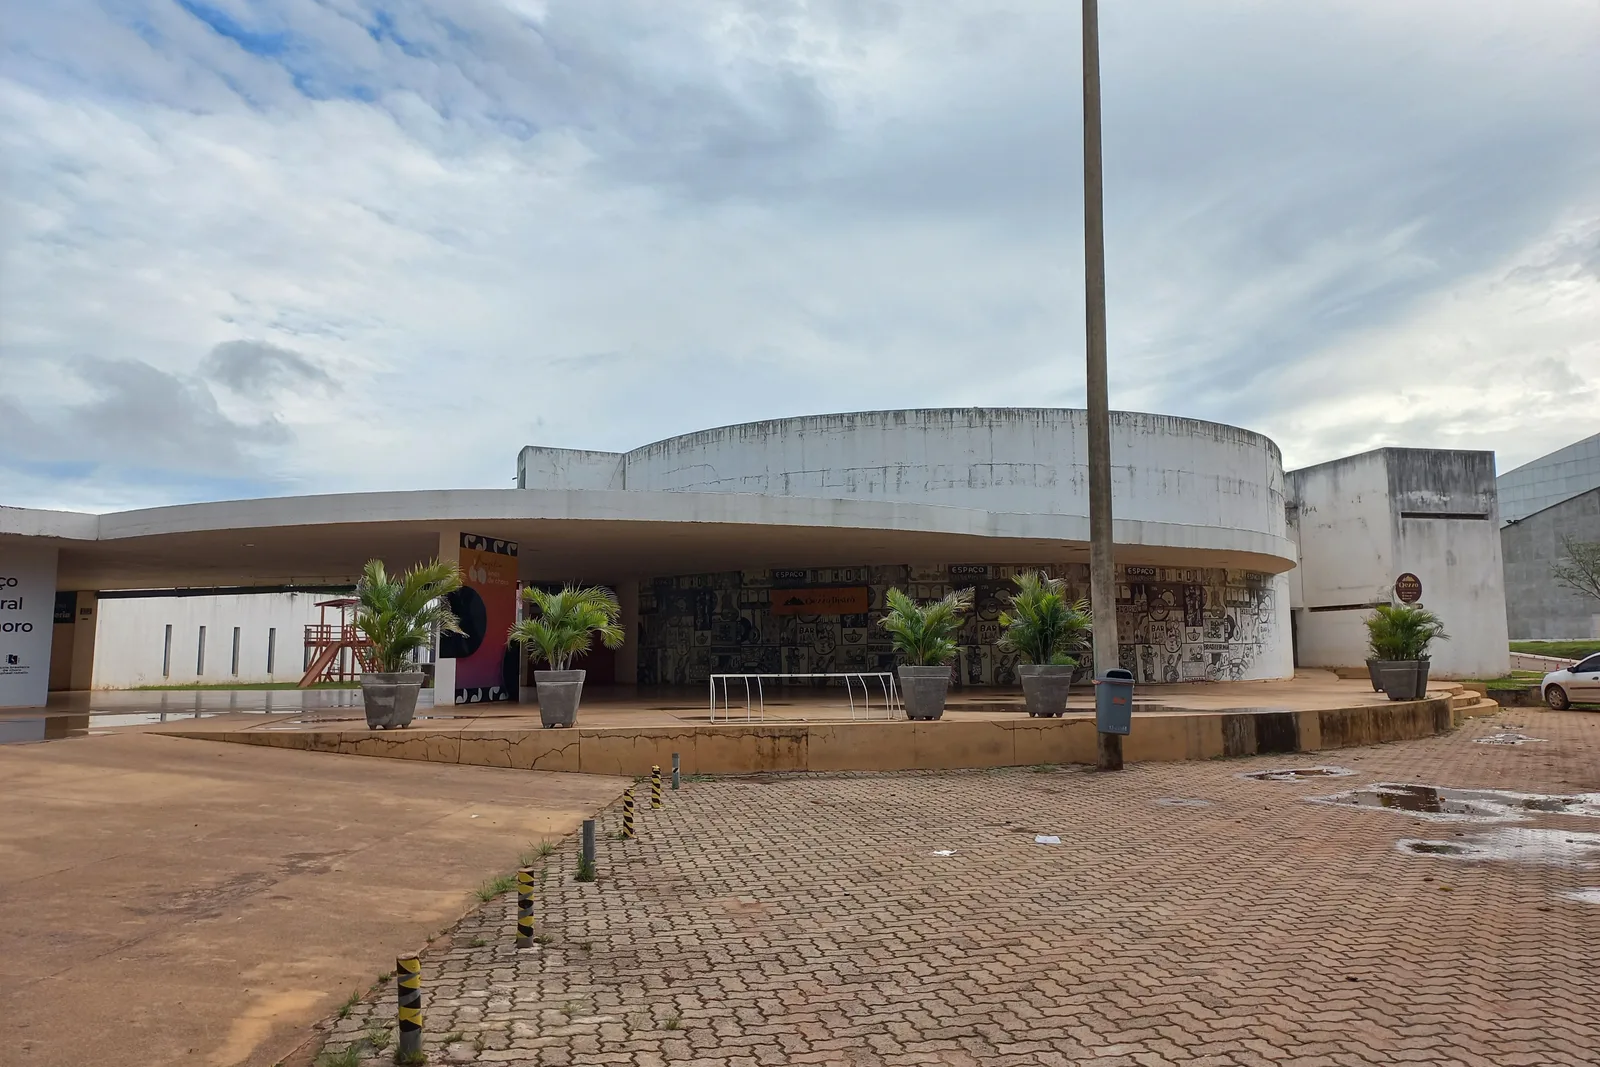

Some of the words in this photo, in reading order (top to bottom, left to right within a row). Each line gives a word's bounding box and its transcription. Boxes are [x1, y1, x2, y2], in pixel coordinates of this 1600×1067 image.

[0, 597, 23, 610] ral
[0, 622, 33, 632] oro
[799, 626, 815, 634] BAR
[981, 624, 997, 632] BAR
[1151, 624, 1165, 632] BAR
